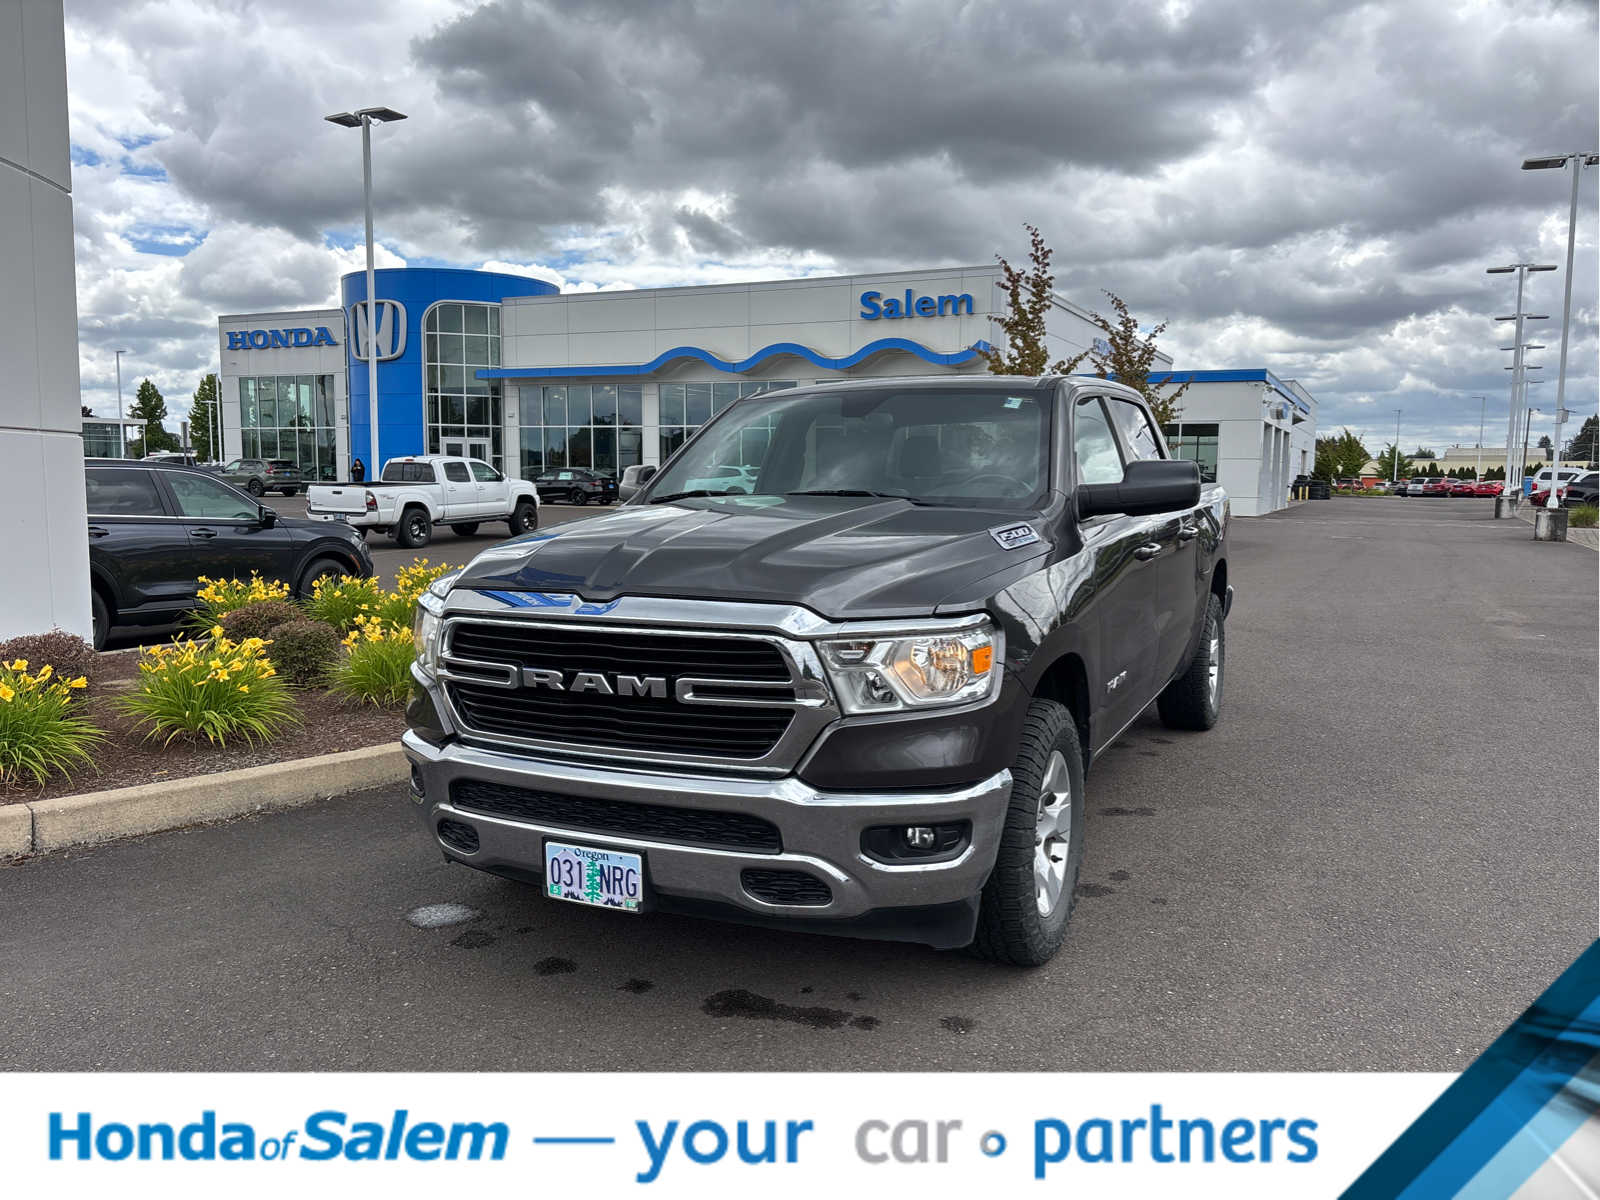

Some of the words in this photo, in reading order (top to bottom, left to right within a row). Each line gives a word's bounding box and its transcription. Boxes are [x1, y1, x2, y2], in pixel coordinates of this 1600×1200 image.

[861, 289, 974, 320] Salem
[227, 328, 338, 349] HONDA
[998, 527, 1029, 541] 1500
[522, 667, 668, 698] RAM
[574, 847, 609, 862] Oregon
[551, 857, 583, 889] 031
[599, 864, 637, 897] NRG
